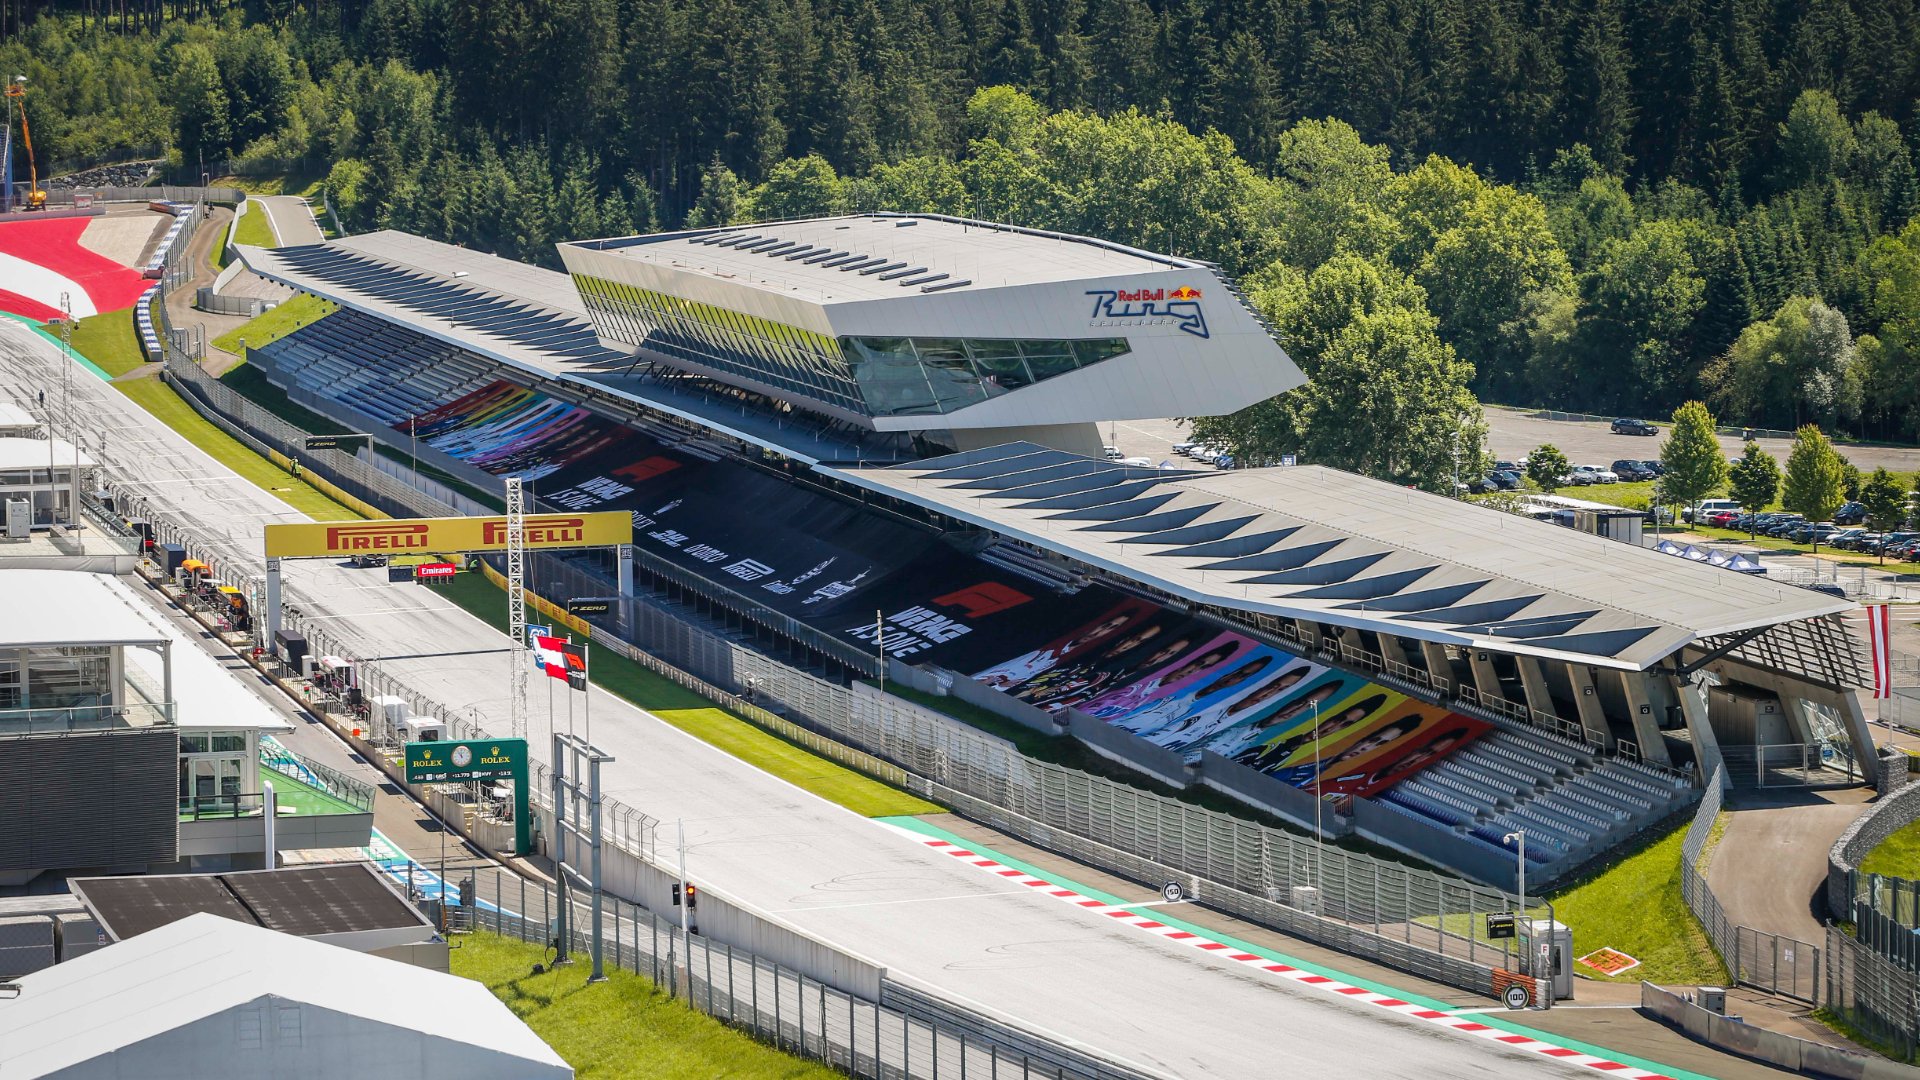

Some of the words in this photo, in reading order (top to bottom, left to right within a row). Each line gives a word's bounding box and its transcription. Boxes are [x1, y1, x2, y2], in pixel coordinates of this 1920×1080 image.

[1118, 289, 1140, 301] Red
[1142, 289, 1164, 301] Bull
[327, 524, 429, 550] PIRELLI
[421, 567, 453, 575] Emirates
[480, 756, 510, 764] ROLEX
[1510, 993, 1524, 1001] 100
